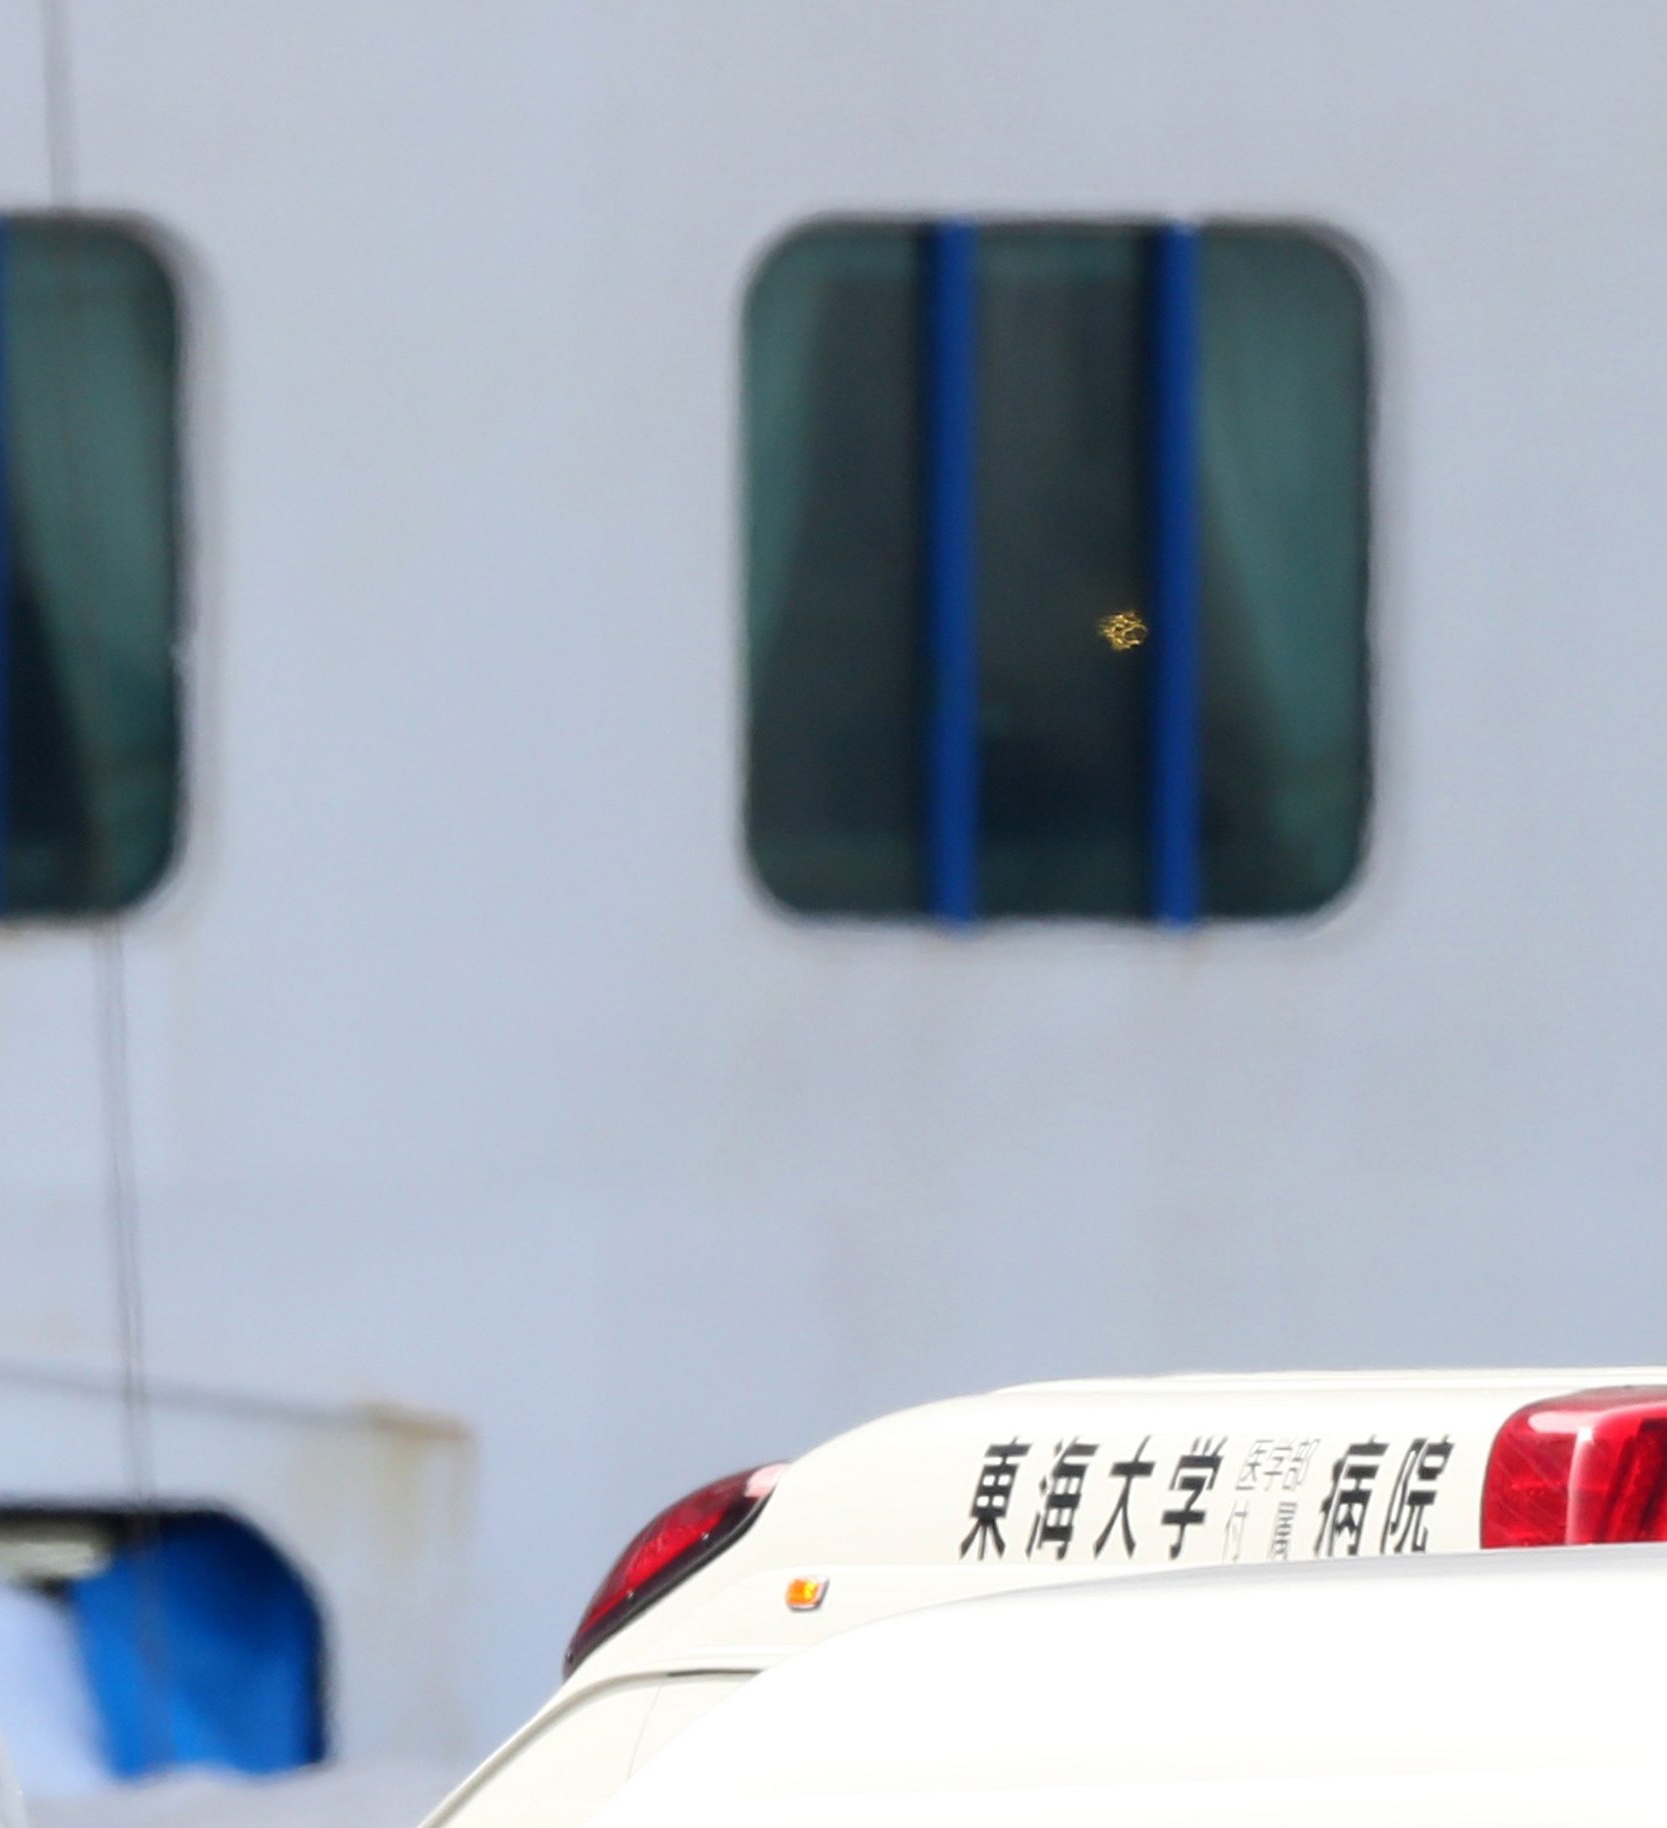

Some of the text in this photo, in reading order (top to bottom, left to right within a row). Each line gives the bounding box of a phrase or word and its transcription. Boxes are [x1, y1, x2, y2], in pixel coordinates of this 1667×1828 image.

[959, 1434, 1227, 1561] 東海大学
[1313, 1434, 1455, 1558] 病院
